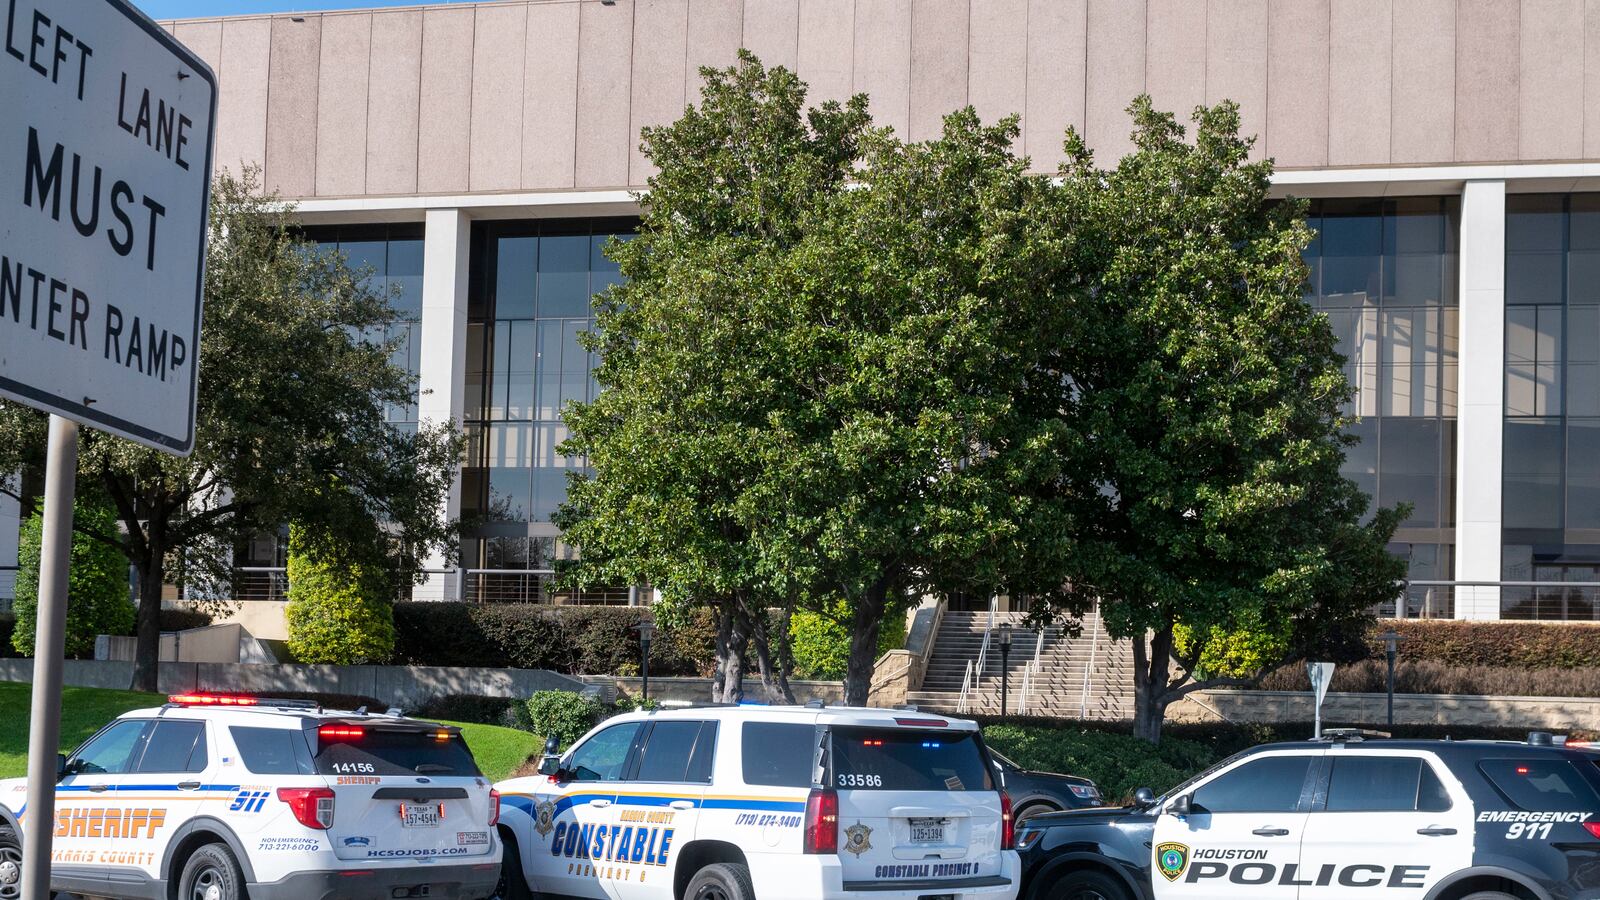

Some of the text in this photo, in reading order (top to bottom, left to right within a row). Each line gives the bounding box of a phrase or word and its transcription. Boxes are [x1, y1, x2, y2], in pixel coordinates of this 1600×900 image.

[6, 0, 192, 171] LEFT LANE
[24, 127, 166, 271] MUST
[104, 304, 187, 382] RAMP
[332, 763, 375, 773] 14156
[337, 776, 381, 785] SHERIFF
[838, 774, 882, 787] 33586
[230, 791, 270, 813] 911
[57, 808, 167, 839] SHERIFF
[619, 809, 676, 824] HARRIS COUNTY
[735, 813, 759, 826] (713)
[1476, 811, 1594, 822] EMERGENCY
[1505, 822, 1554, 840] 911
[258, 843, 319, 851] 713-221-6000
[550, 820, 676, 867] CONSTABLE
[1160, 844, 1186, 853] HOUSTON
[50, 850, 155, 865] ARRIS COUNTY
[367, 847, 468, 857] HCSOJOBS.COM
[1193, 849, 1269, 860] HOUSTON
[568, 863, 631, 881] PRECINCT
[875, 864, 929, 879] CONSTABLE
[932, 862, 972, 876] PRECINCT
[1163, 868, 1182, 876] POLICE
[1184, 862, 1431, 888] POLICE
